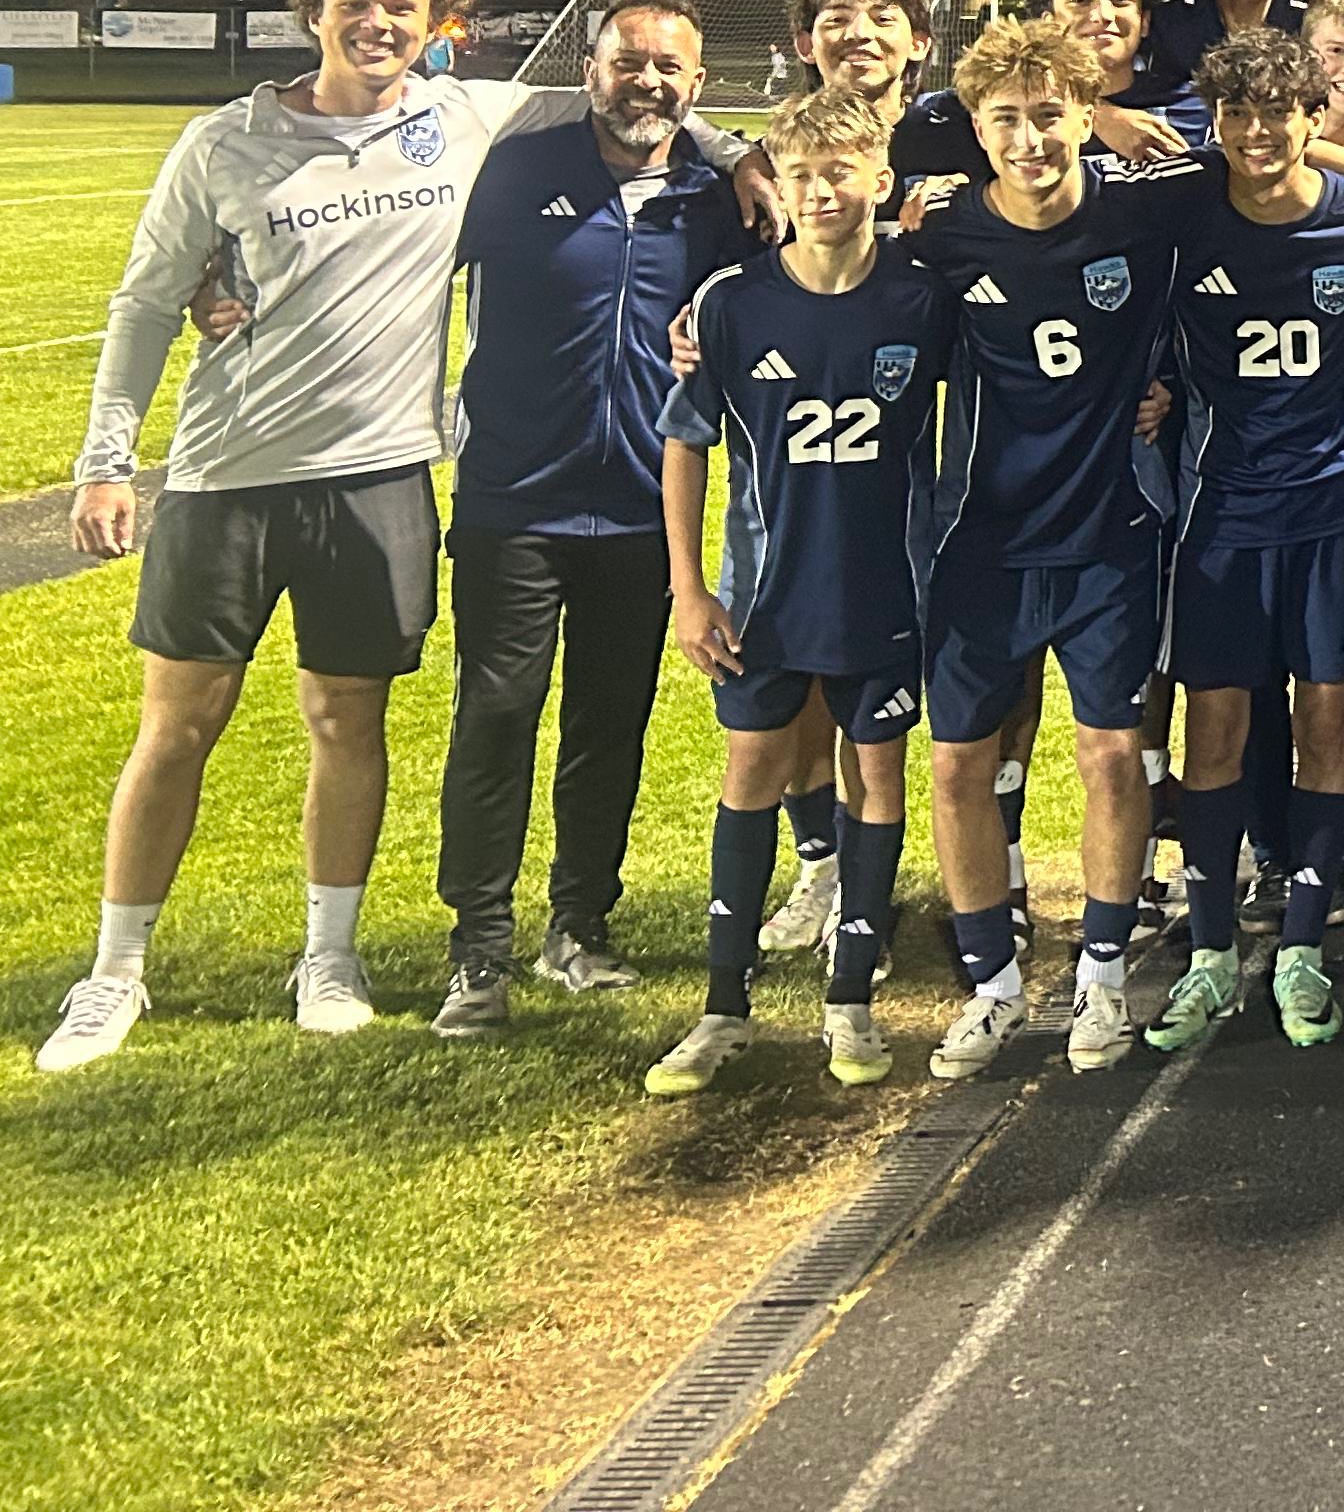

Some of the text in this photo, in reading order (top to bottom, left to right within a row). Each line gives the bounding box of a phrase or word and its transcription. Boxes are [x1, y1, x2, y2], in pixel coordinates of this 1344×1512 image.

[266, 184, 455, 236] Hockinson
[1032, 319, 1083, 378] 6
[1236, 320, 1321, 377] 20
[787, 398, 882, 464] 22
